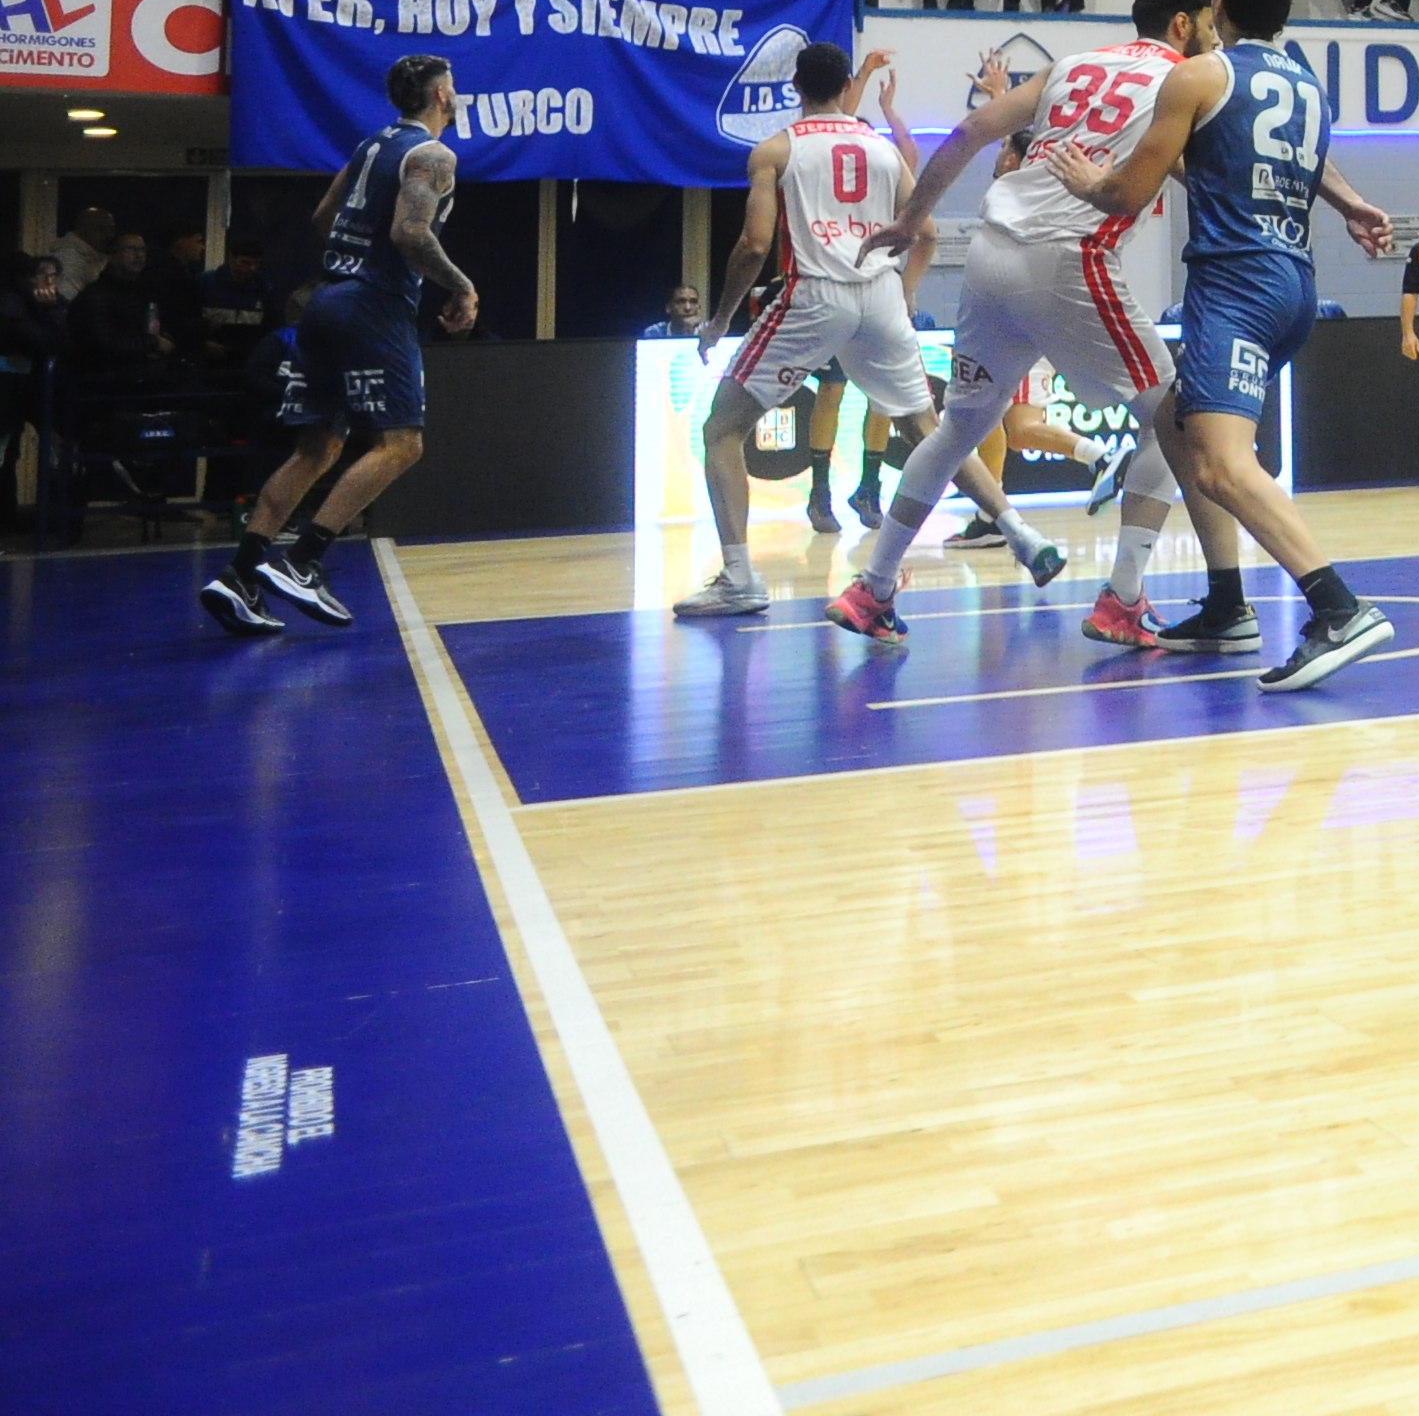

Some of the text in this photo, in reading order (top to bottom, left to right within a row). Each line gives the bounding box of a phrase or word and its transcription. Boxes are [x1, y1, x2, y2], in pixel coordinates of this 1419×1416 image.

[456, 87, 594, 140] TURCO
[1049, 63, 1153, 136] 35
[1250, 70, 1321, 173] 21
[831, 144, 868, 203] 0
